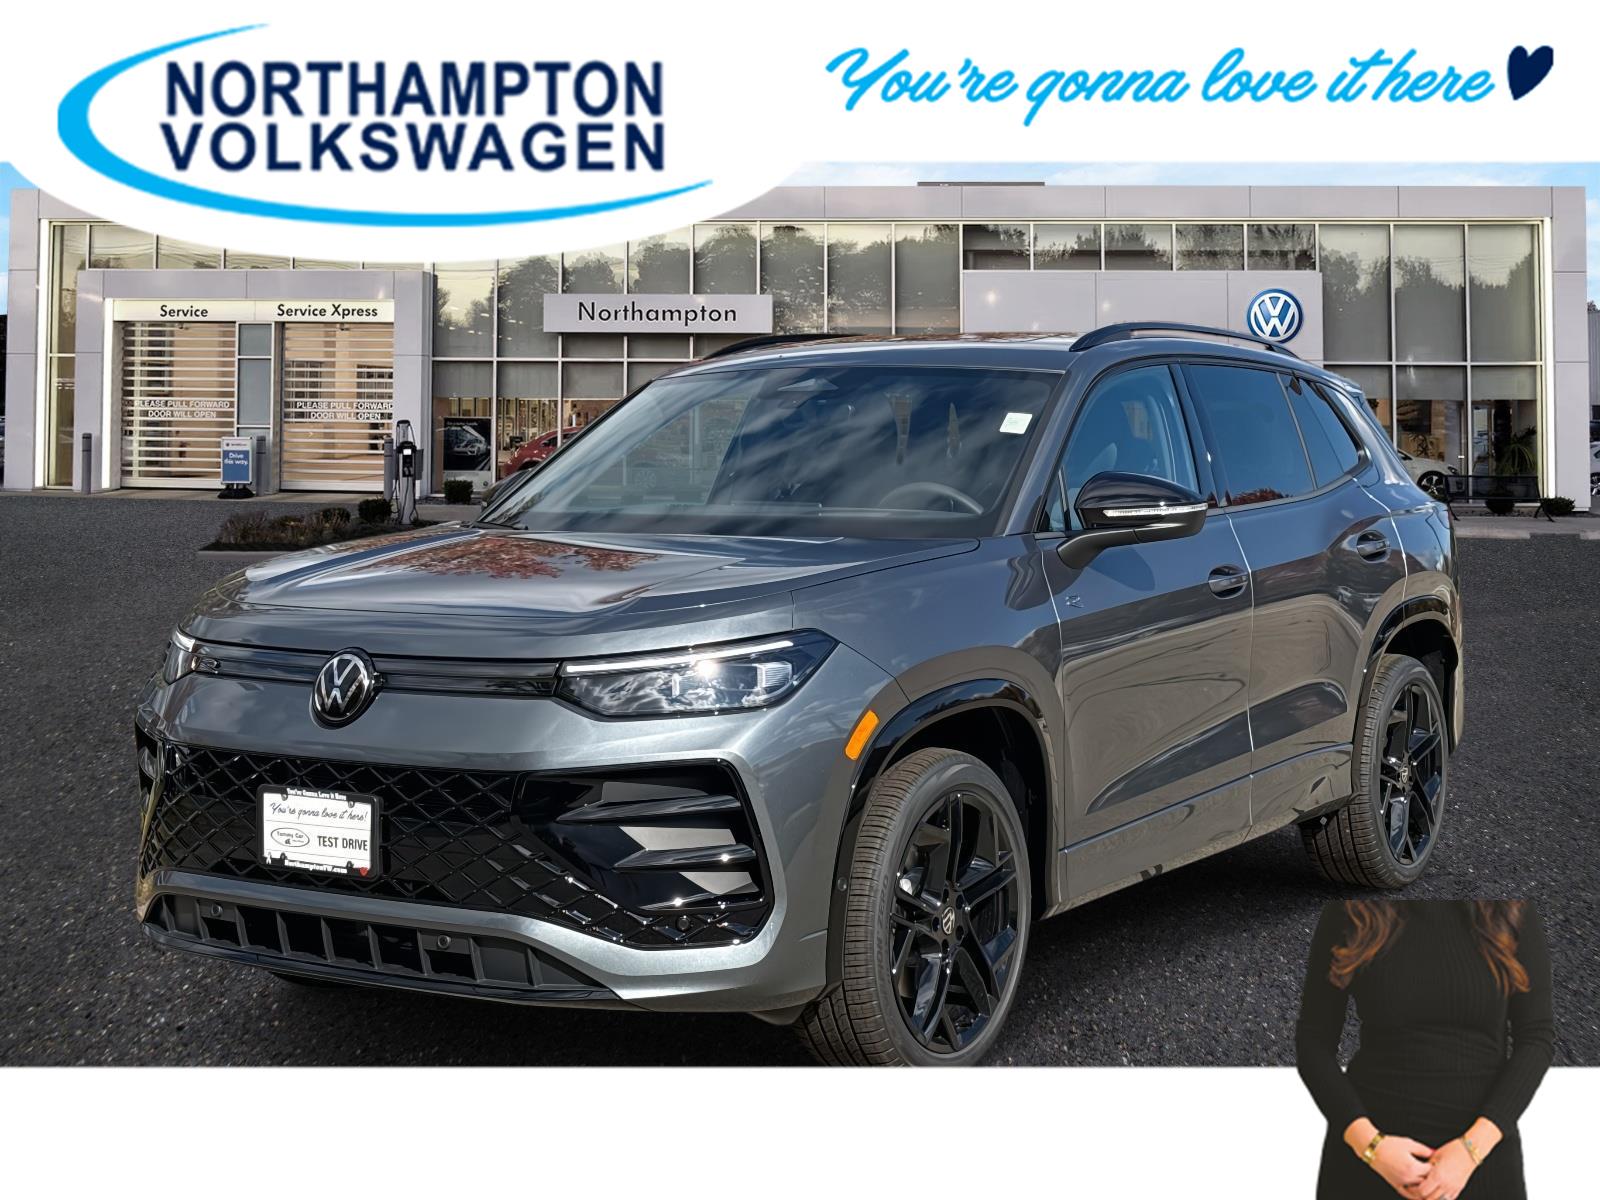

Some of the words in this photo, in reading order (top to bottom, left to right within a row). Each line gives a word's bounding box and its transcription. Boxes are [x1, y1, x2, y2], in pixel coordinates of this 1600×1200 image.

[160, 304, 209, 318] Service
[277, 304, 327, 317] Service
[331, 304, 378, 320] Xpress
[578, 301, 737, 326] Northampton
[135, 400, 165, 408] PLEASE
[167, 400, 188, 408] PULL
[189, 400, 230, 409] FORWARD
[296, 401, 329, 409] PLEASE
[330, 401, 352, 409] PULL
[353, 401, 395, 410] FORWARD
[148, 410, 171, 418] DOOR
[173, 410, 193, 418] WILL
[194, 410, 217, 418] OPEN
[310, 412, 335, 420] DOOR
[336, 412, 357, 420] WILL
[357, 412, 381, 420] OPEN
[270, 802, 296, 815] You're
[297, 809, 320, 821] gonna
[321, 807, 337, 819] love
[338, 810, 348, 820] it
[317, 835, 339, 848] TEST
[341, 837, 368, 851] DRIVE
